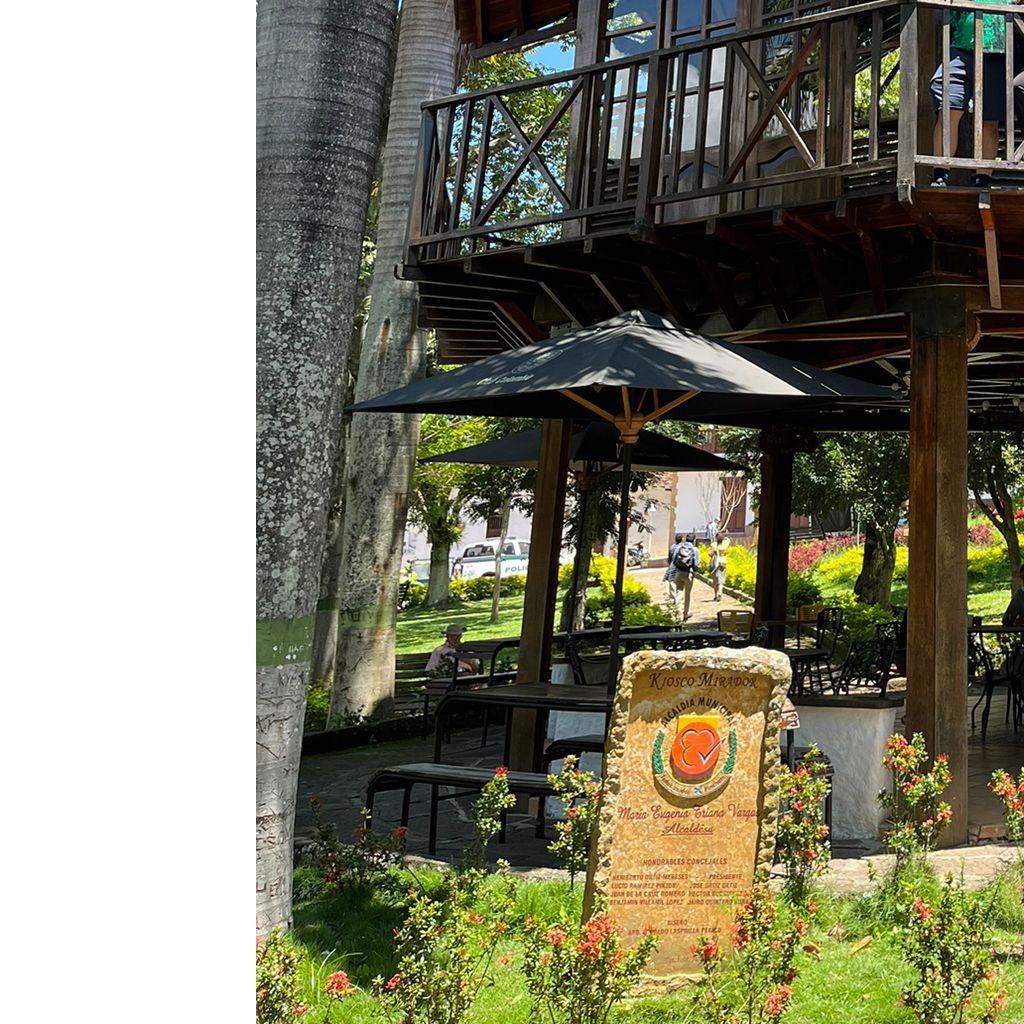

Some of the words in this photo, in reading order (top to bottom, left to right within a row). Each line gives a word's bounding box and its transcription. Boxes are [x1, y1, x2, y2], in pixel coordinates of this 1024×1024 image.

[661, 698, 695, 727] ALCALDIA
[698, 696, 736, 727] MUNICIPAL
[650, 804, 690, 823] Eugenia
[662, 822, 714, 834] Alcaldesa
[643, 857, 686, 866] HONORABLES
[687, 857, 728, 866] CONCEJALES
